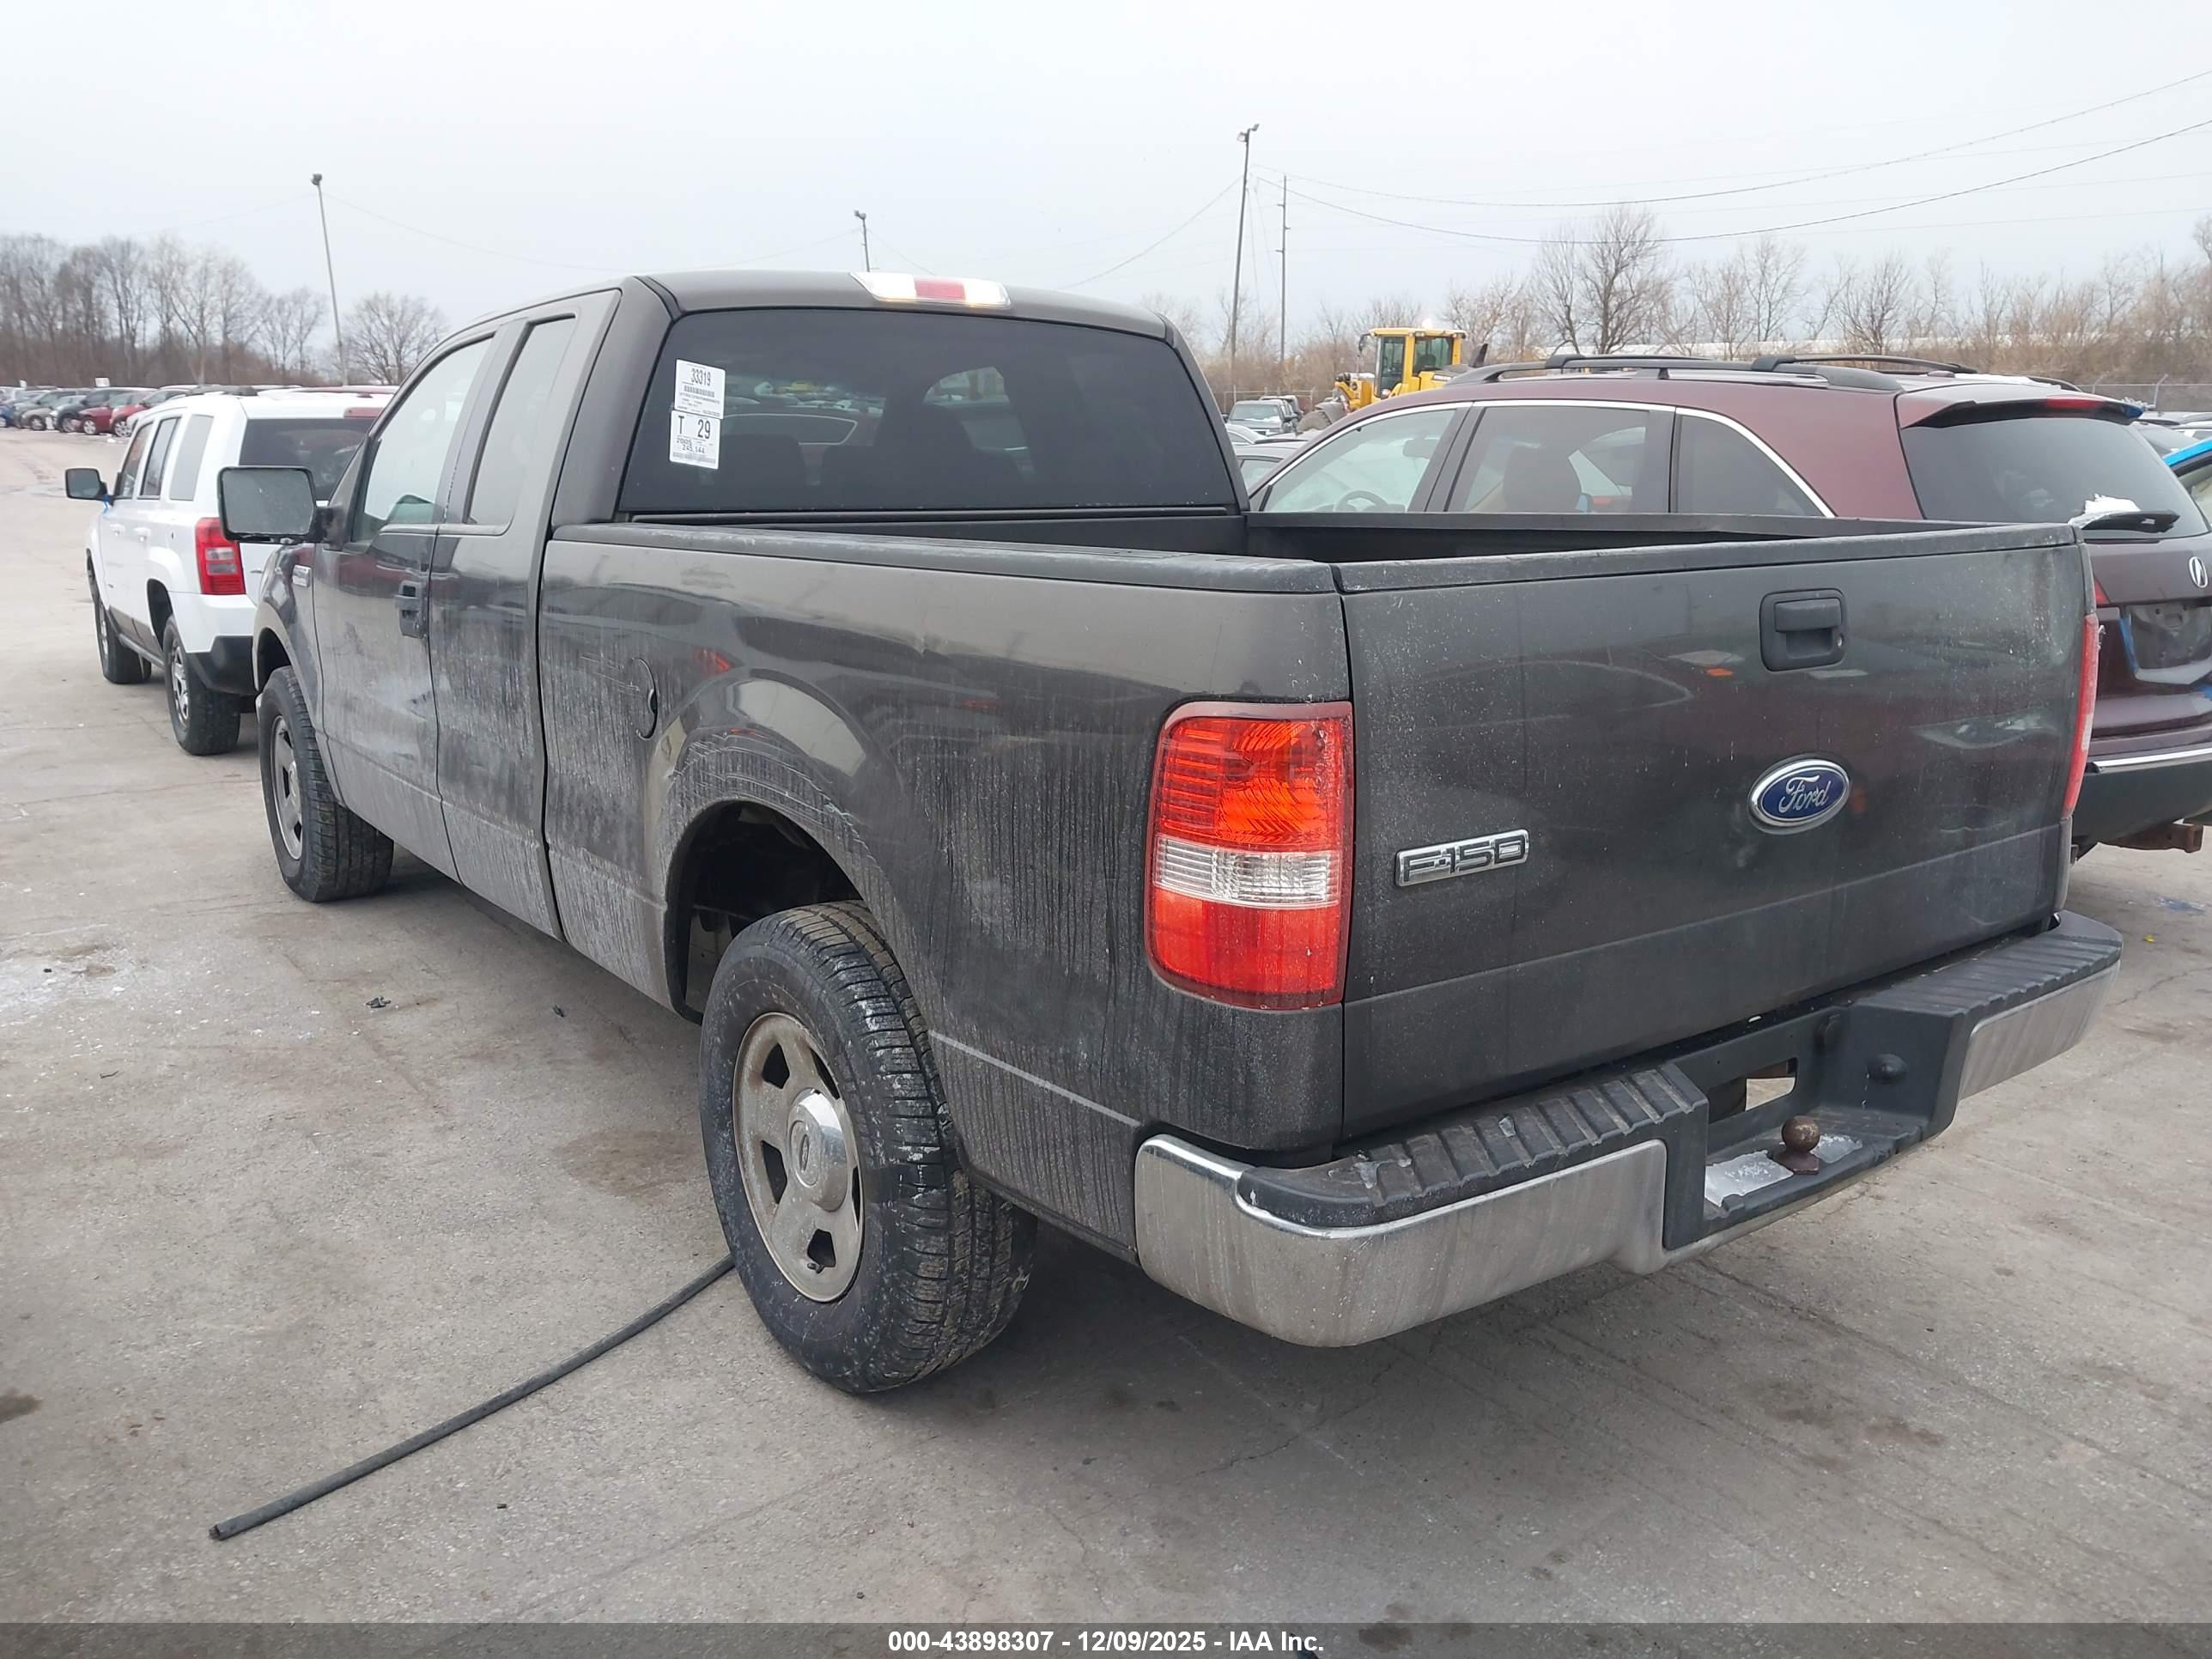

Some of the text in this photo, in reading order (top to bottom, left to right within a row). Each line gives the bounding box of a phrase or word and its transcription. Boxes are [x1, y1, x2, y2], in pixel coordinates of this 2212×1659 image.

[691, 368, 711, 386] 33319
[678, 416, 711, 439] T 29
[1778, 775, 1832, 813] Ford
